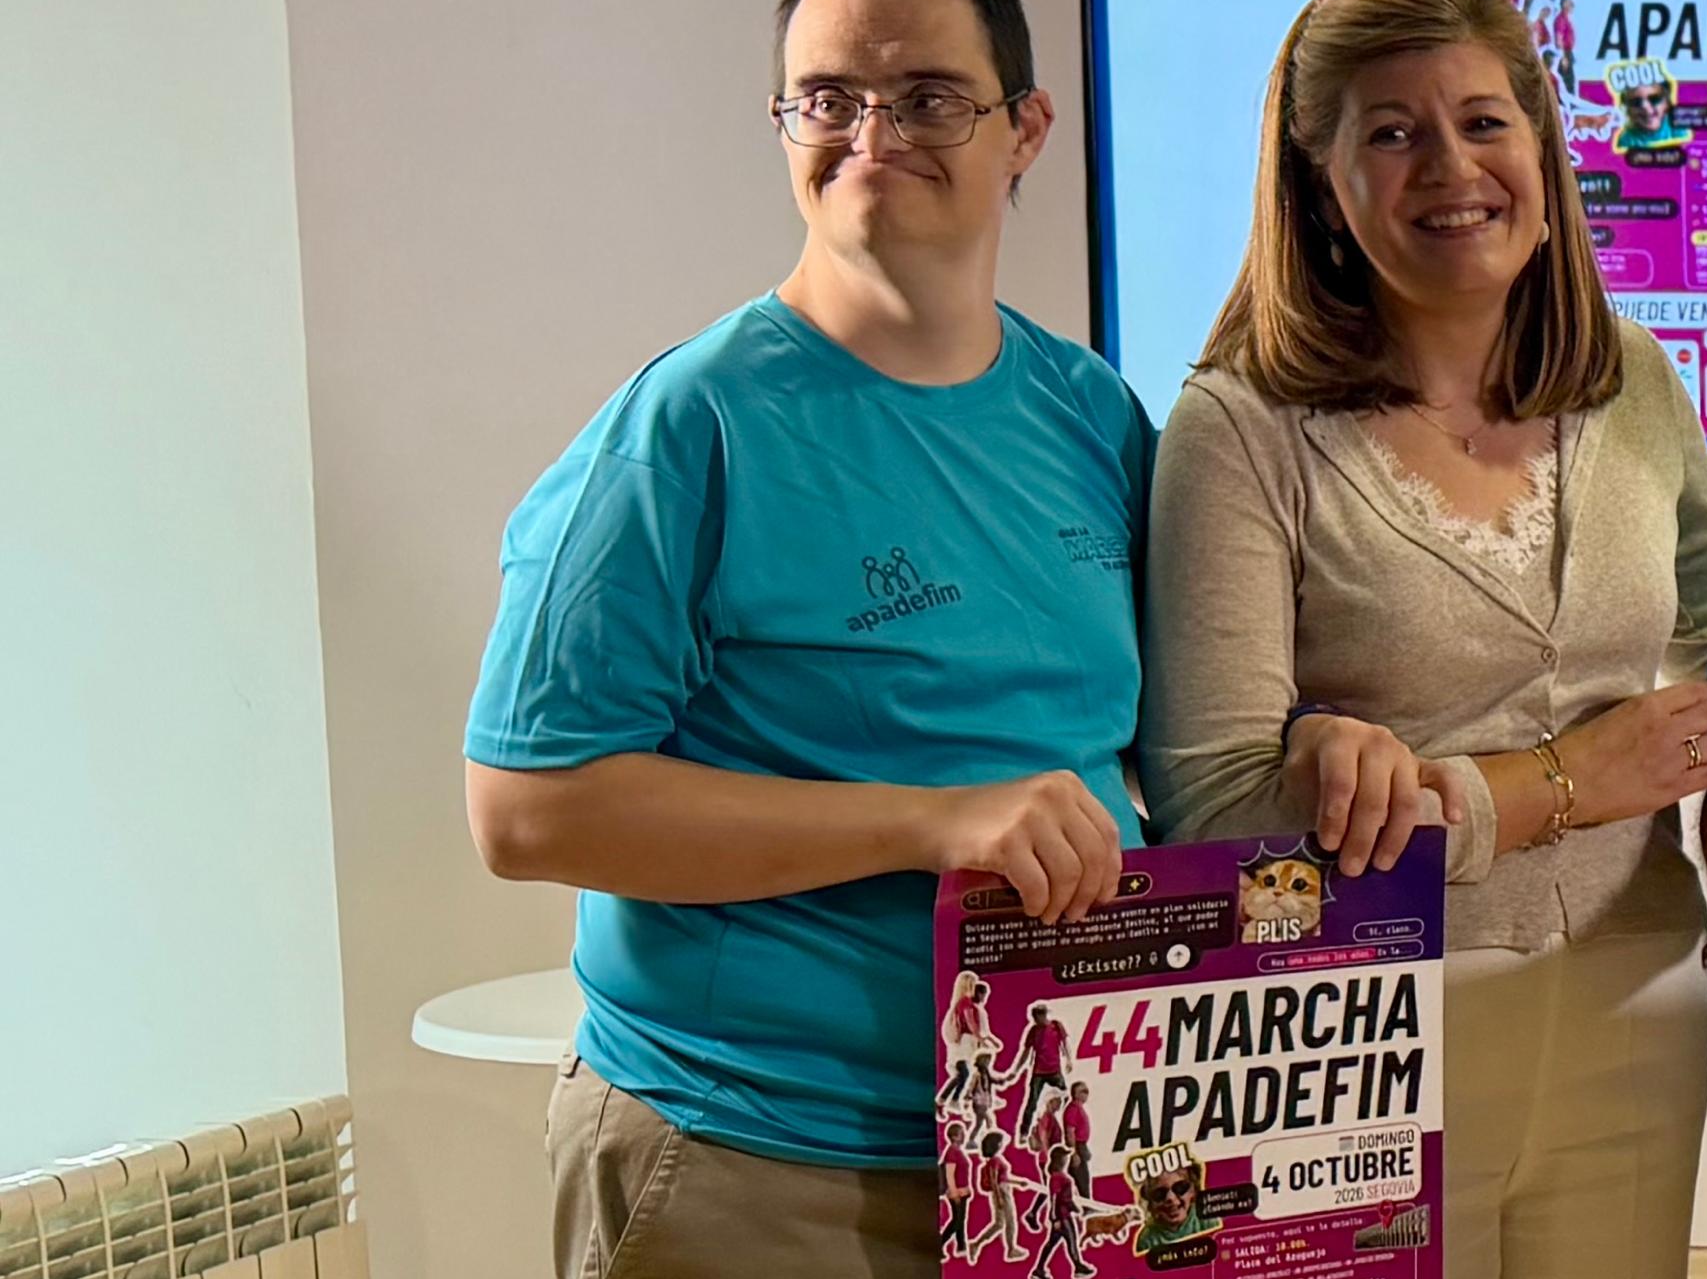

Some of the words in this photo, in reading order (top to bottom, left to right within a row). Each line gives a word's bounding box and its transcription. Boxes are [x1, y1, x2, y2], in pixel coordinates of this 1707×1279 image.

[845, 582, 961, 632] apadefim
[1255, 918, 1301, 942] PLIS
[1112, 1047, 1424, 1153] APADEFIM
[1130, 1144, 1193, 1183] COOL
[1261, 1166, 1280, 1192] 4
[1289, 1146, 1414, 1190] OCTUBRE
